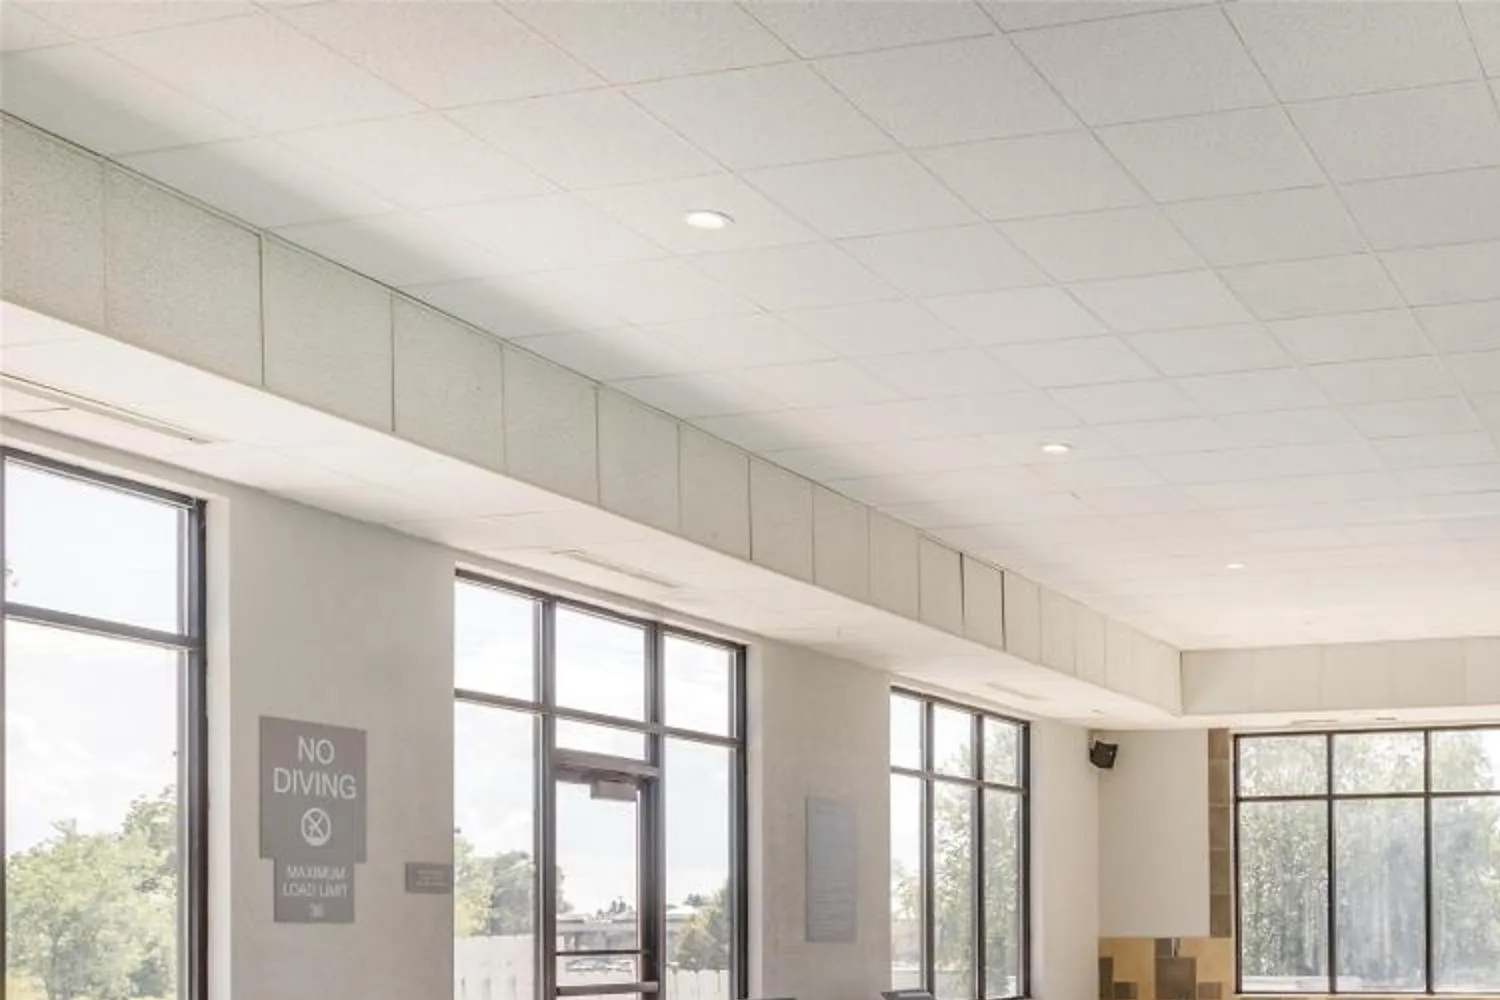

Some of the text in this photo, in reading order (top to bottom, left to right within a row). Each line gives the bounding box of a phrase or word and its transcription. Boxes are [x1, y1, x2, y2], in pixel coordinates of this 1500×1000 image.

[298, 735, 335, 765] NO
[273, 767, 357, 800] DIVING
[286, 864, 347, 880] MAXIMUM
[283, 882, 347, 898] LOAD LIMIT
